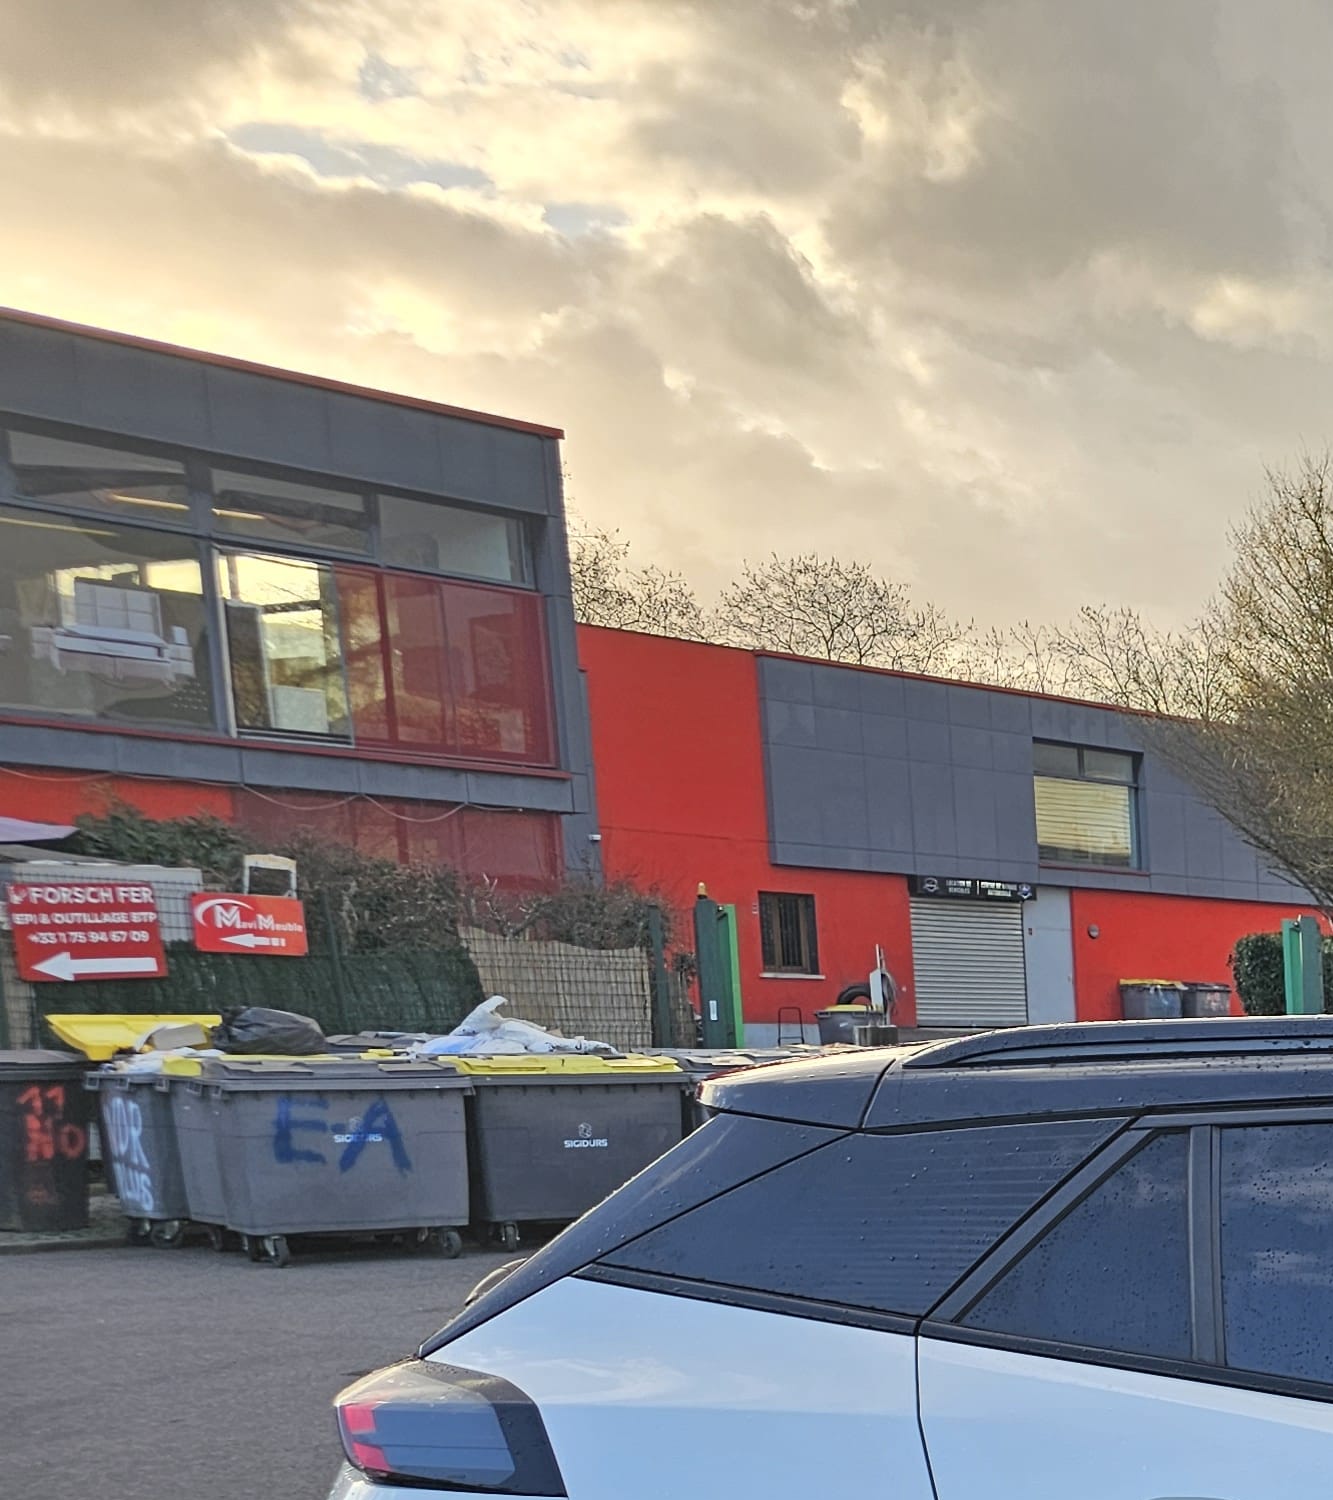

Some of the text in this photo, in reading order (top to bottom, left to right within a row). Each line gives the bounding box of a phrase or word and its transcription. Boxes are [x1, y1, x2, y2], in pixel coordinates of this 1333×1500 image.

[28, 886, 155, 904] FORSCH FER
[51, 912, 130, 925] OUTILLAGE
[214, 904, 303, 932] Mavi Meuble
